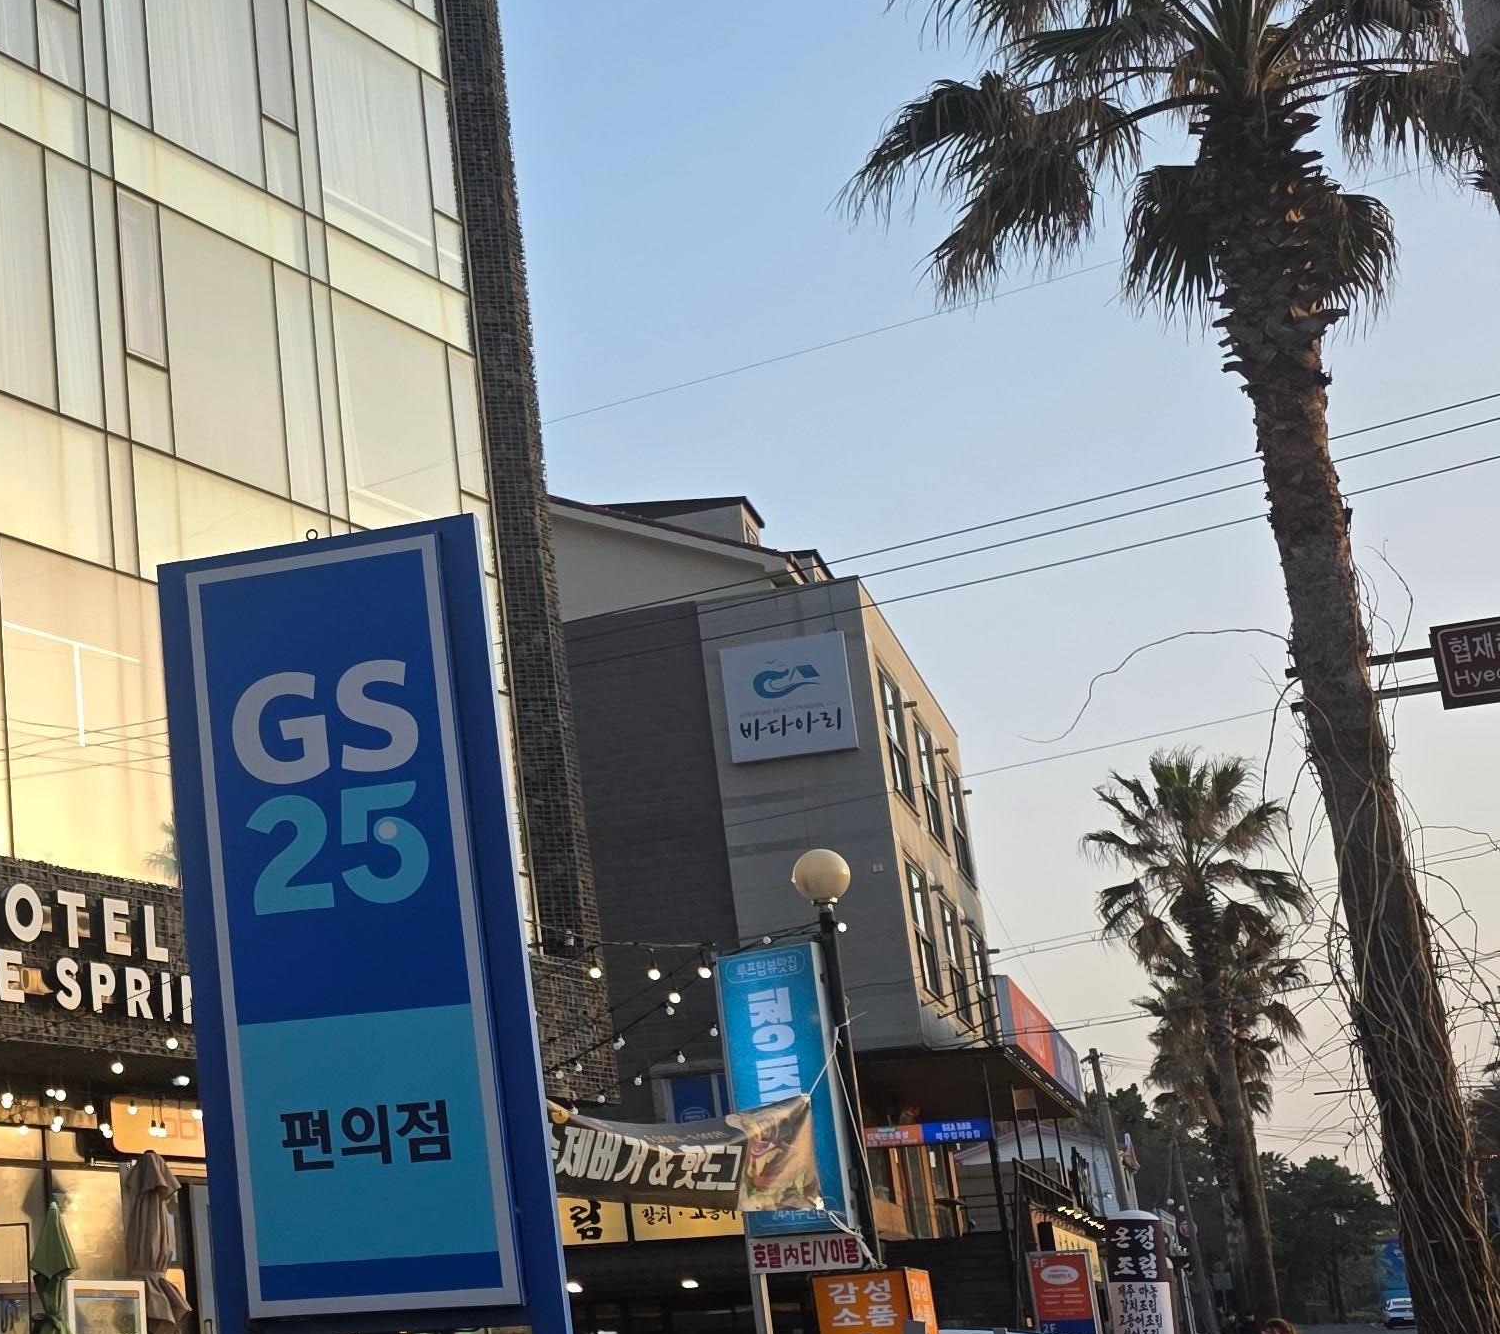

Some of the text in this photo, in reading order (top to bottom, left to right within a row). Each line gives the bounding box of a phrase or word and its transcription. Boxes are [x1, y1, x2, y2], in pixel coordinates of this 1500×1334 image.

[232, 659, 419, 784] GS
[740, 707, 842, 741] 바다아리
[245, 779, 429, 915] 25
[735, 954, 798, 979] 루프탑뷰맛집
[279, 1099, 453, 1173] 편의점
[649, 1145, 676, 1186] &
[672, 1144, 743, 1191] 핫도그
[1111, 1225, 1155, 1250] 온정
[753, 1243, 782, 1268] 호텔
[1032, 1258, 1048, 1268] 2F
[1114, 1253, 1158, 1279] 조림
[828, 1278, 893, 1305] 감성
[831, 1304, 898, 1327] 소품
[1043, 1323, 1058, 1334] 2F
